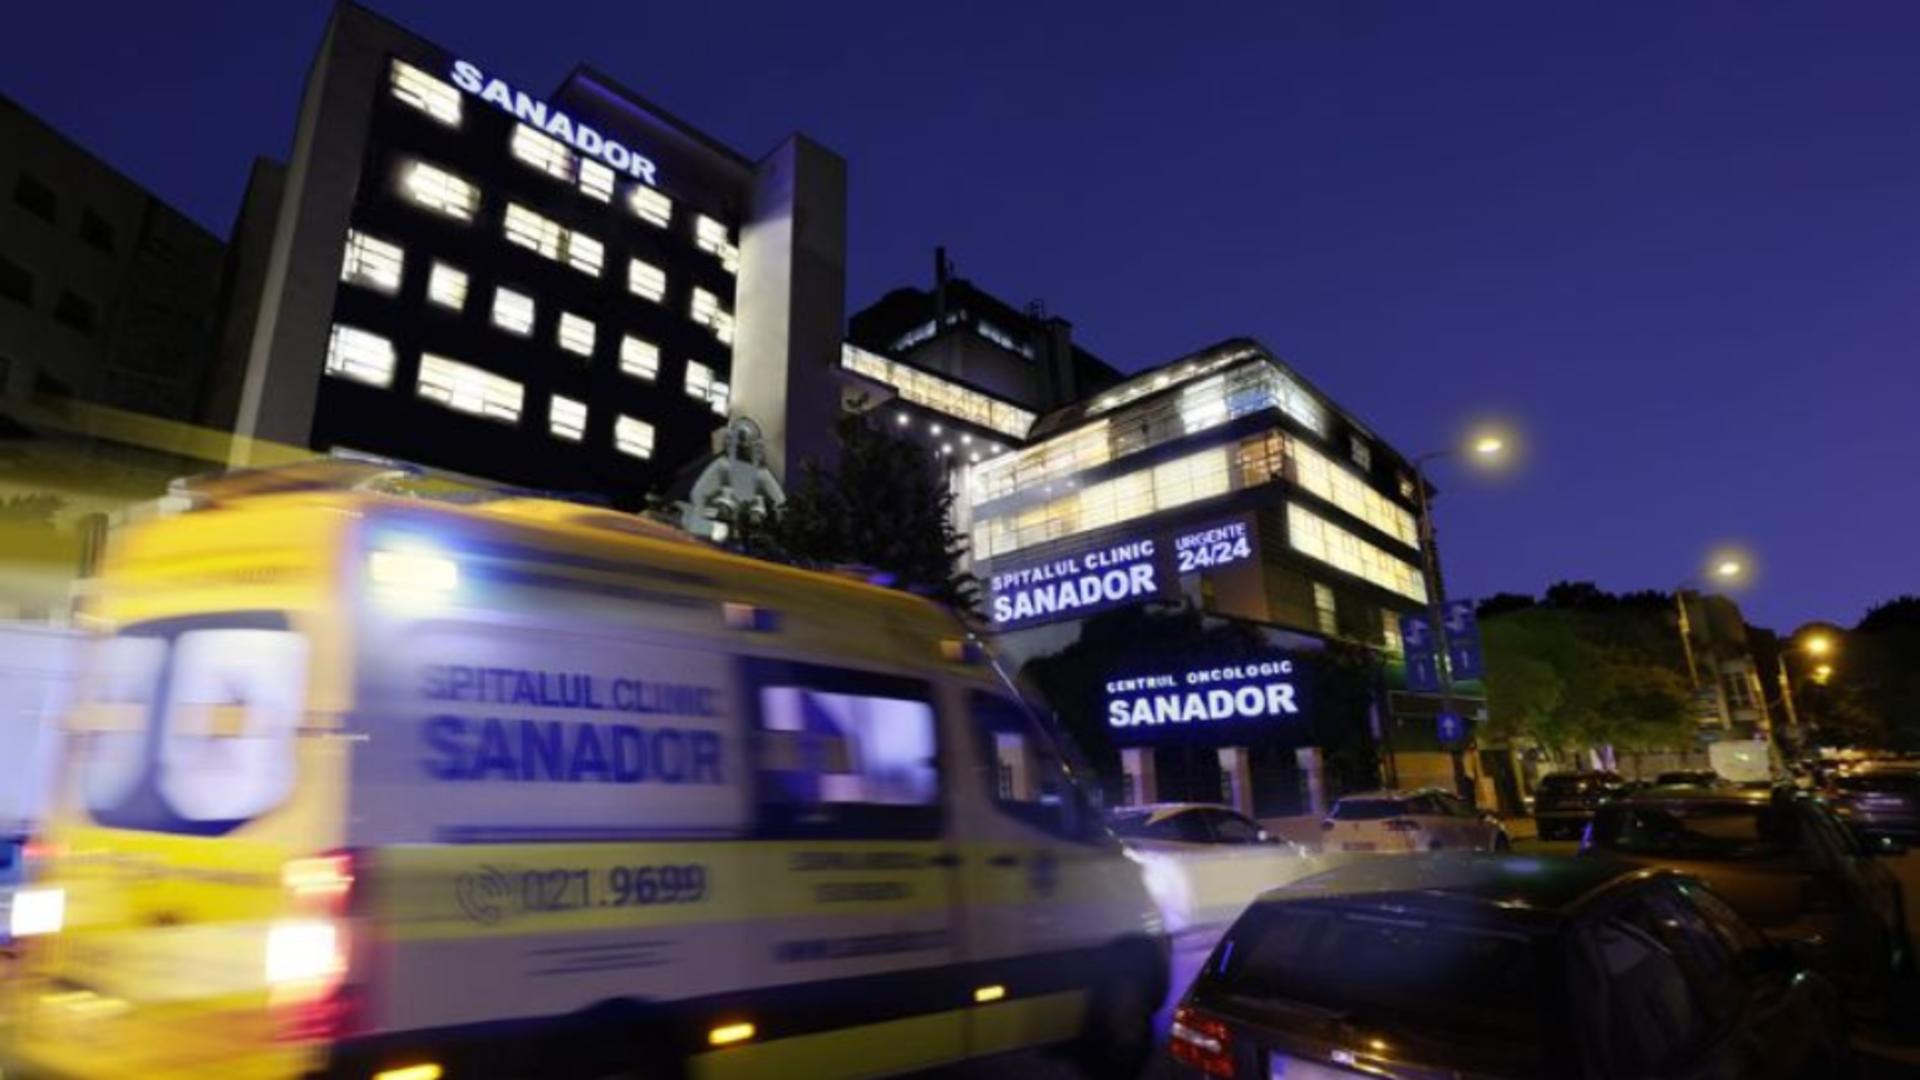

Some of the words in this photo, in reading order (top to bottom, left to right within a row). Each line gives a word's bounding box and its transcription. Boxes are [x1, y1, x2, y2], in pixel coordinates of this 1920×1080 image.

[451, 60, 657, 185] SANADOR
[992, 559, 1080, 590] SPITALUL
[1084, 540, 1154, 569] CLINIC
[1178, 537, 1251, 572] 24/24
[994, 563, 1157, 622] SANADOR
[421, 666, 603, 709] SPITALUL
[1106, 675, 1177, 694] CENTRUL
[1186, 660, 1293, 684] ONCOLOGIC
[1109, 683, 1298, 727] SANADOR
[421, 714, 722, 784] SANADOR
[521, 865, 707, 911] 021.9699
